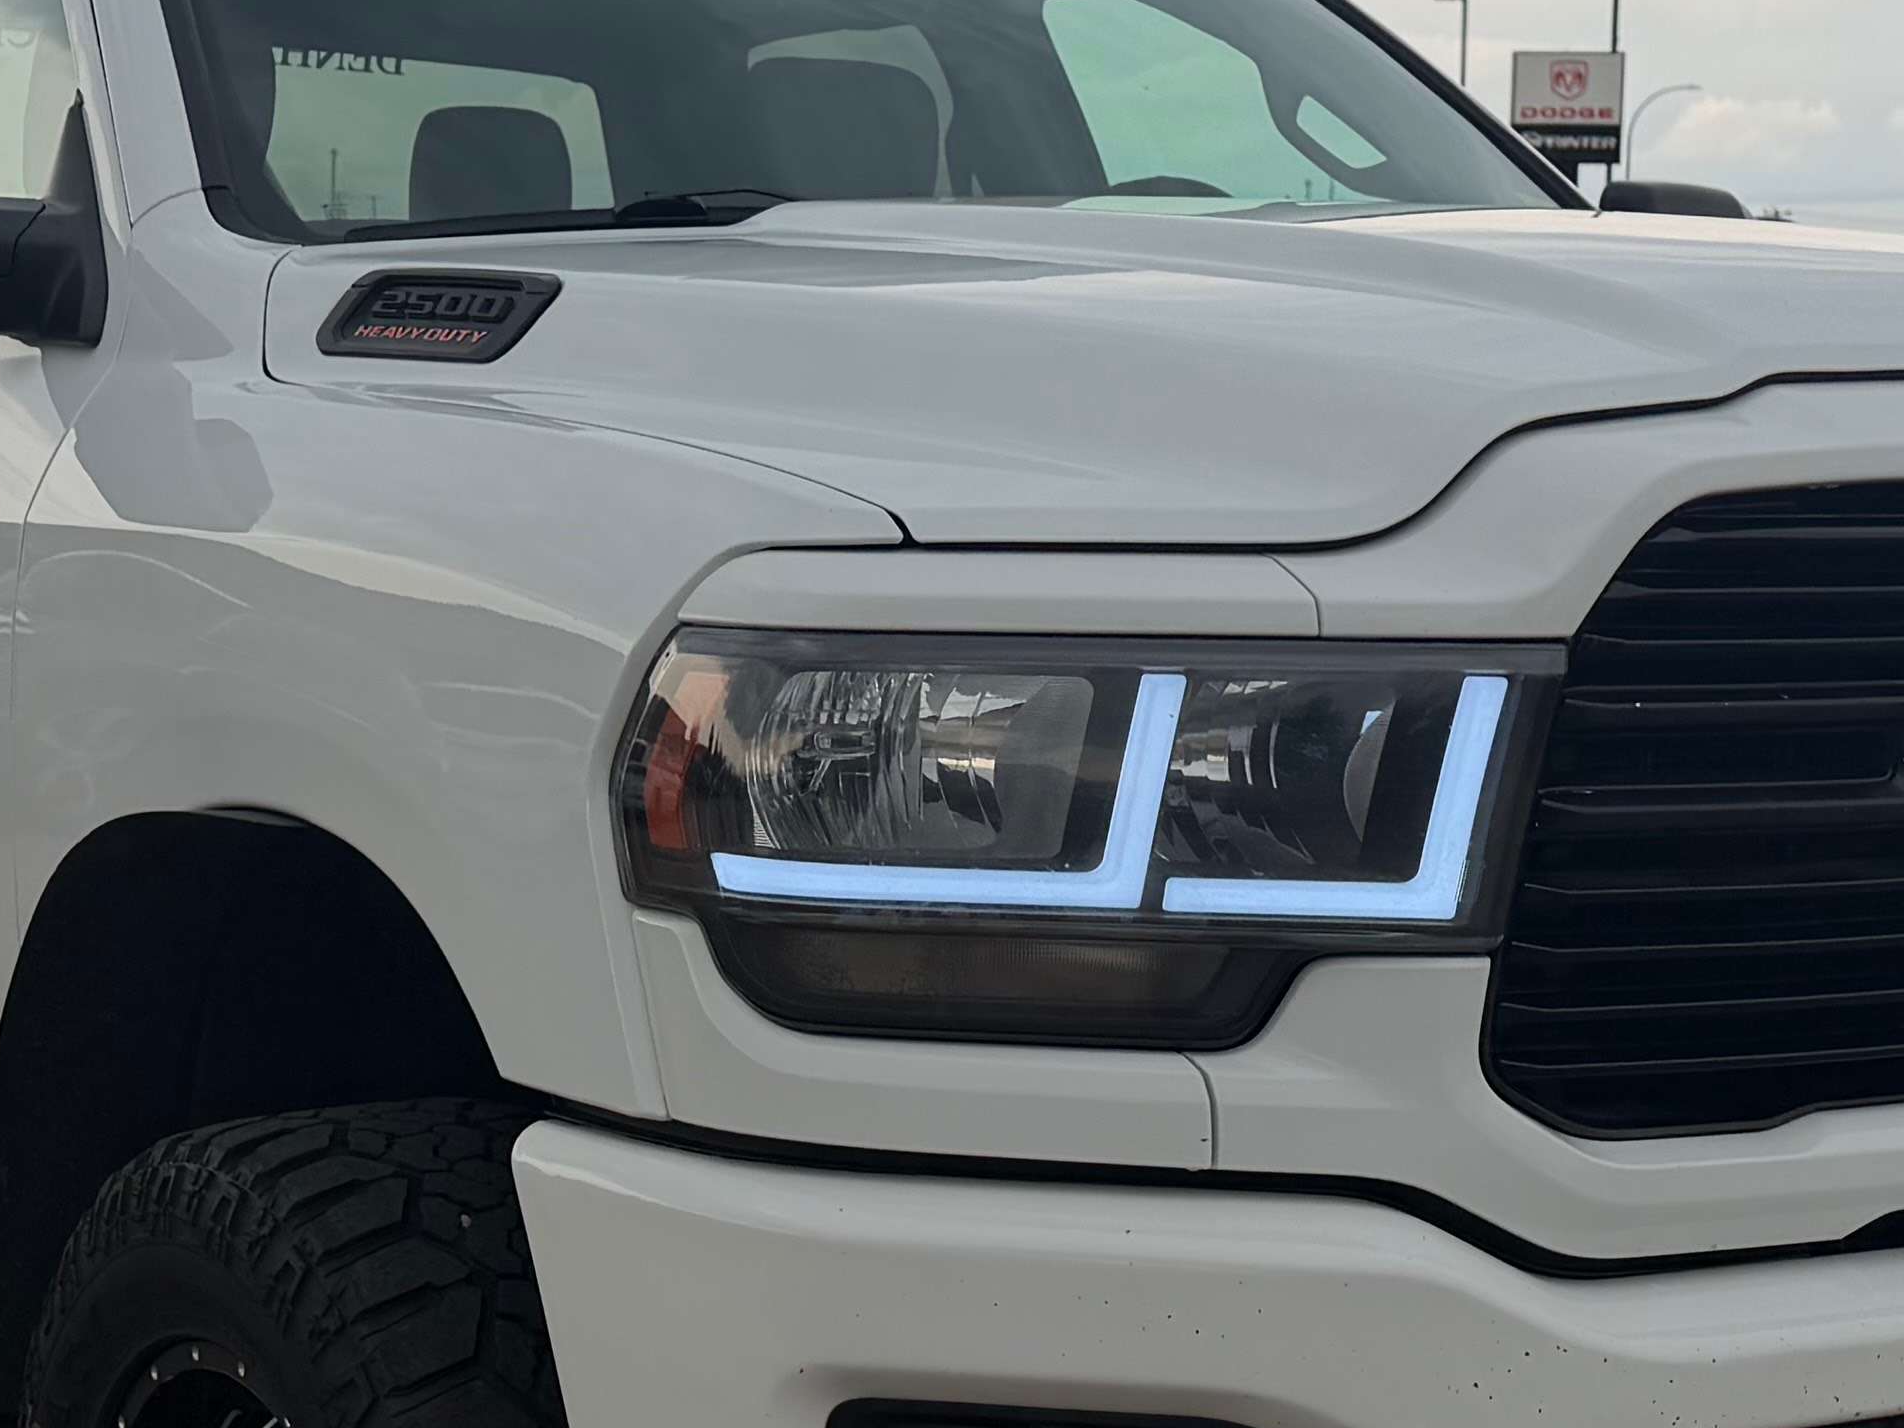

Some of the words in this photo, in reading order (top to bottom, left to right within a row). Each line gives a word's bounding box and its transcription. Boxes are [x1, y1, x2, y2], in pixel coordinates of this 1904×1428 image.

[1520, 106, 1615, 120] DODGE
[371, 289, 515, 324] 2500
[354, 324, 425, 341] HEAVY
[423, 328, 490, 344] DUTY
